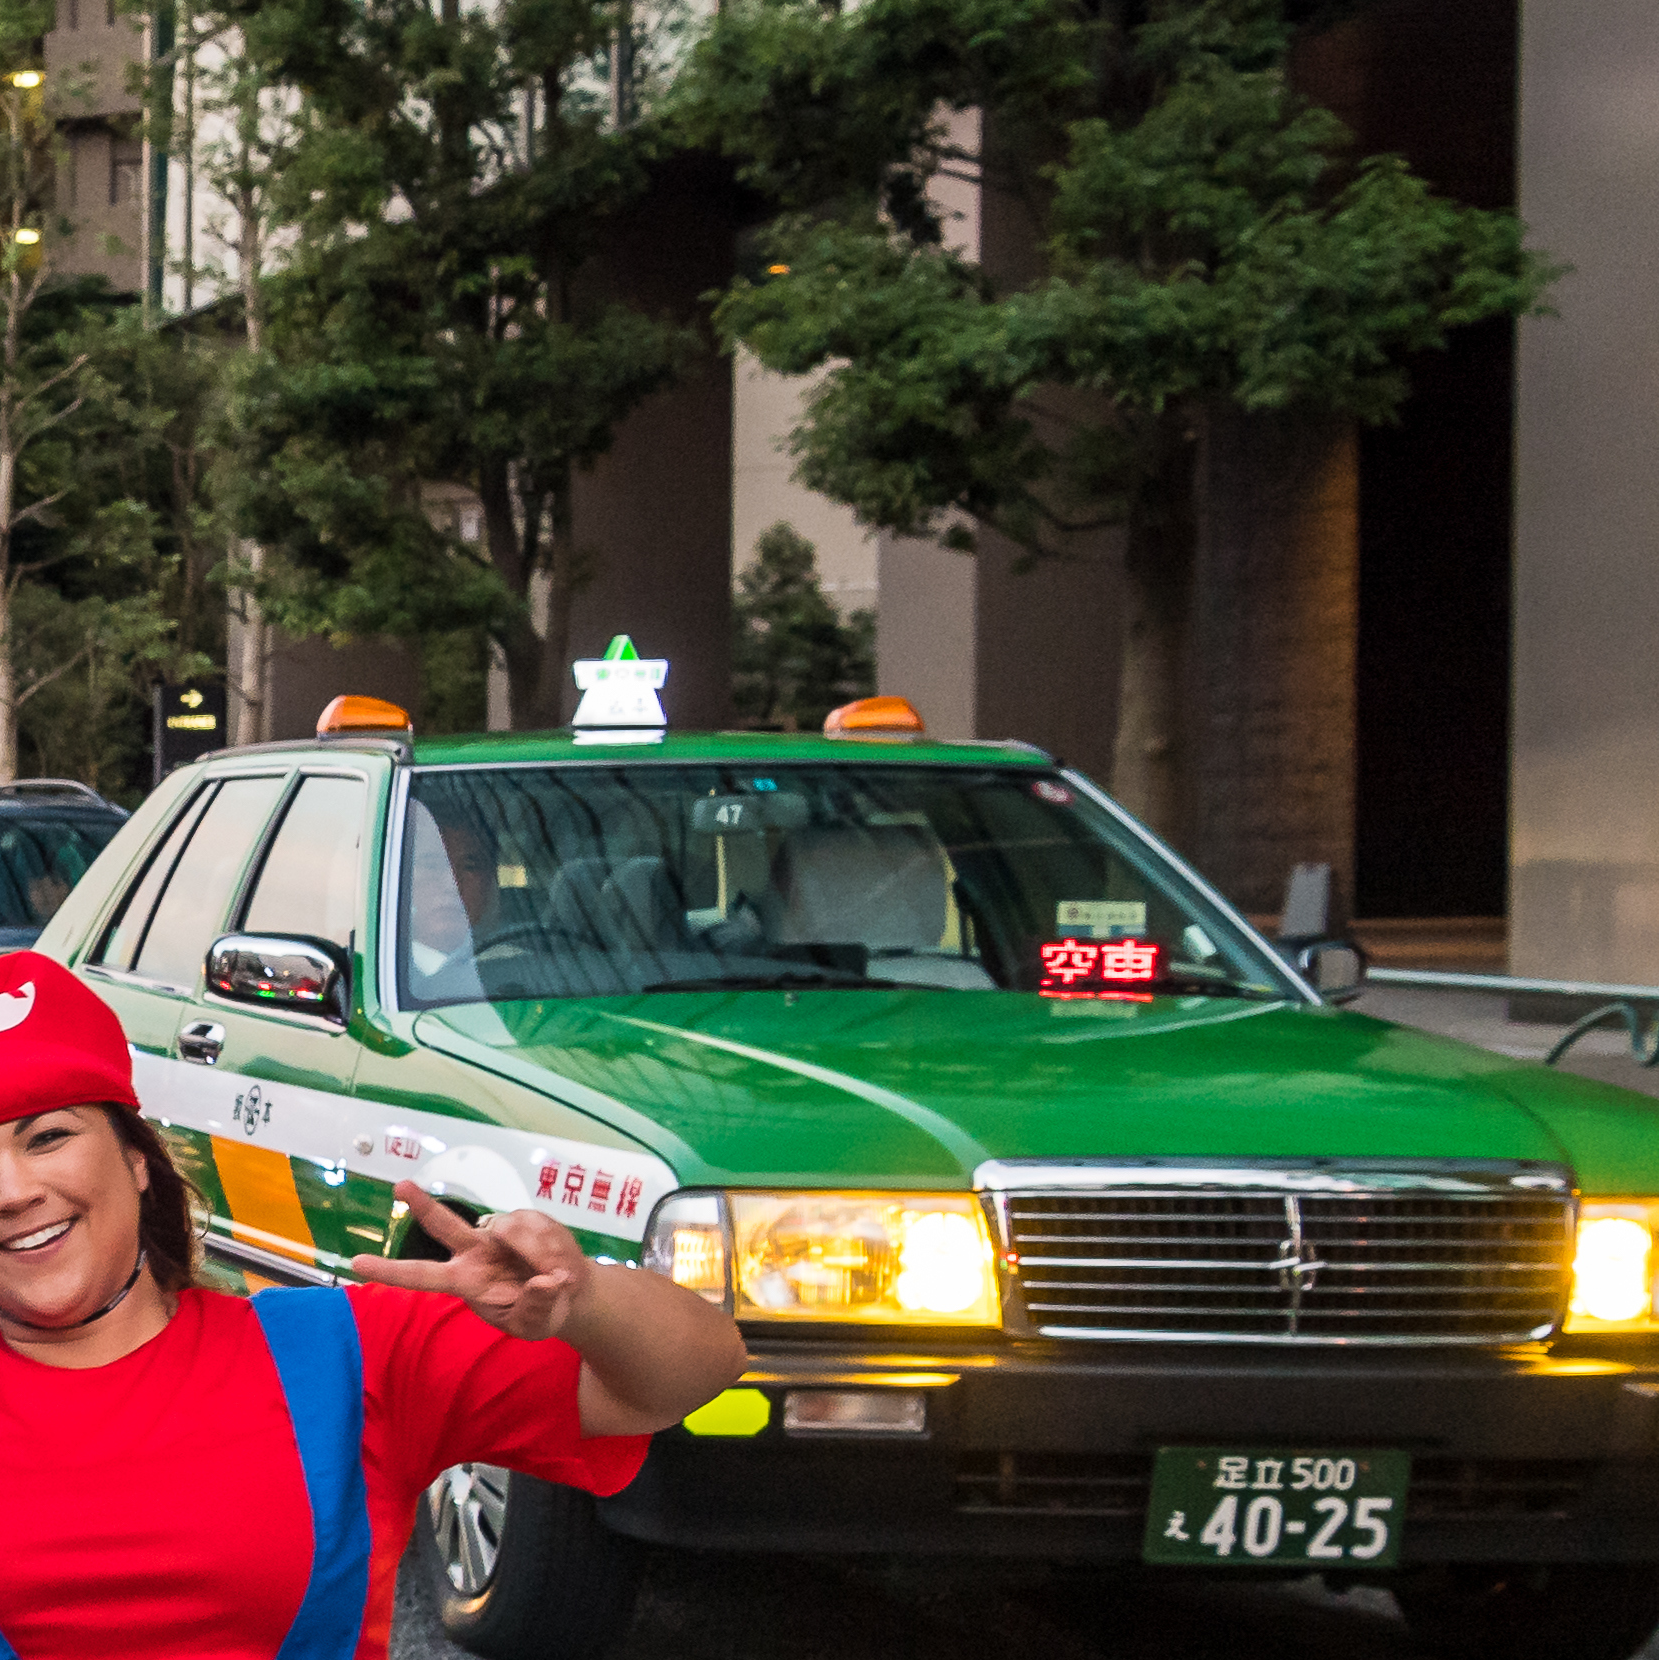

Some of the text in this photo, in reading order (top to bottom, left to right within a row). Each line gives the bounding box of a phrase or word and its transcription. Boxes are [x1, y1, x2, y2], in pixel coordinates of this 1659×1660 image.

[1041, 938, 1159, 984] 空車
[535, 1157, 644, 1219] 東京無線
[1213, 1456, 1358, 1491] 足立 500
[1200, 1494, 1393, 1560] 40-25
